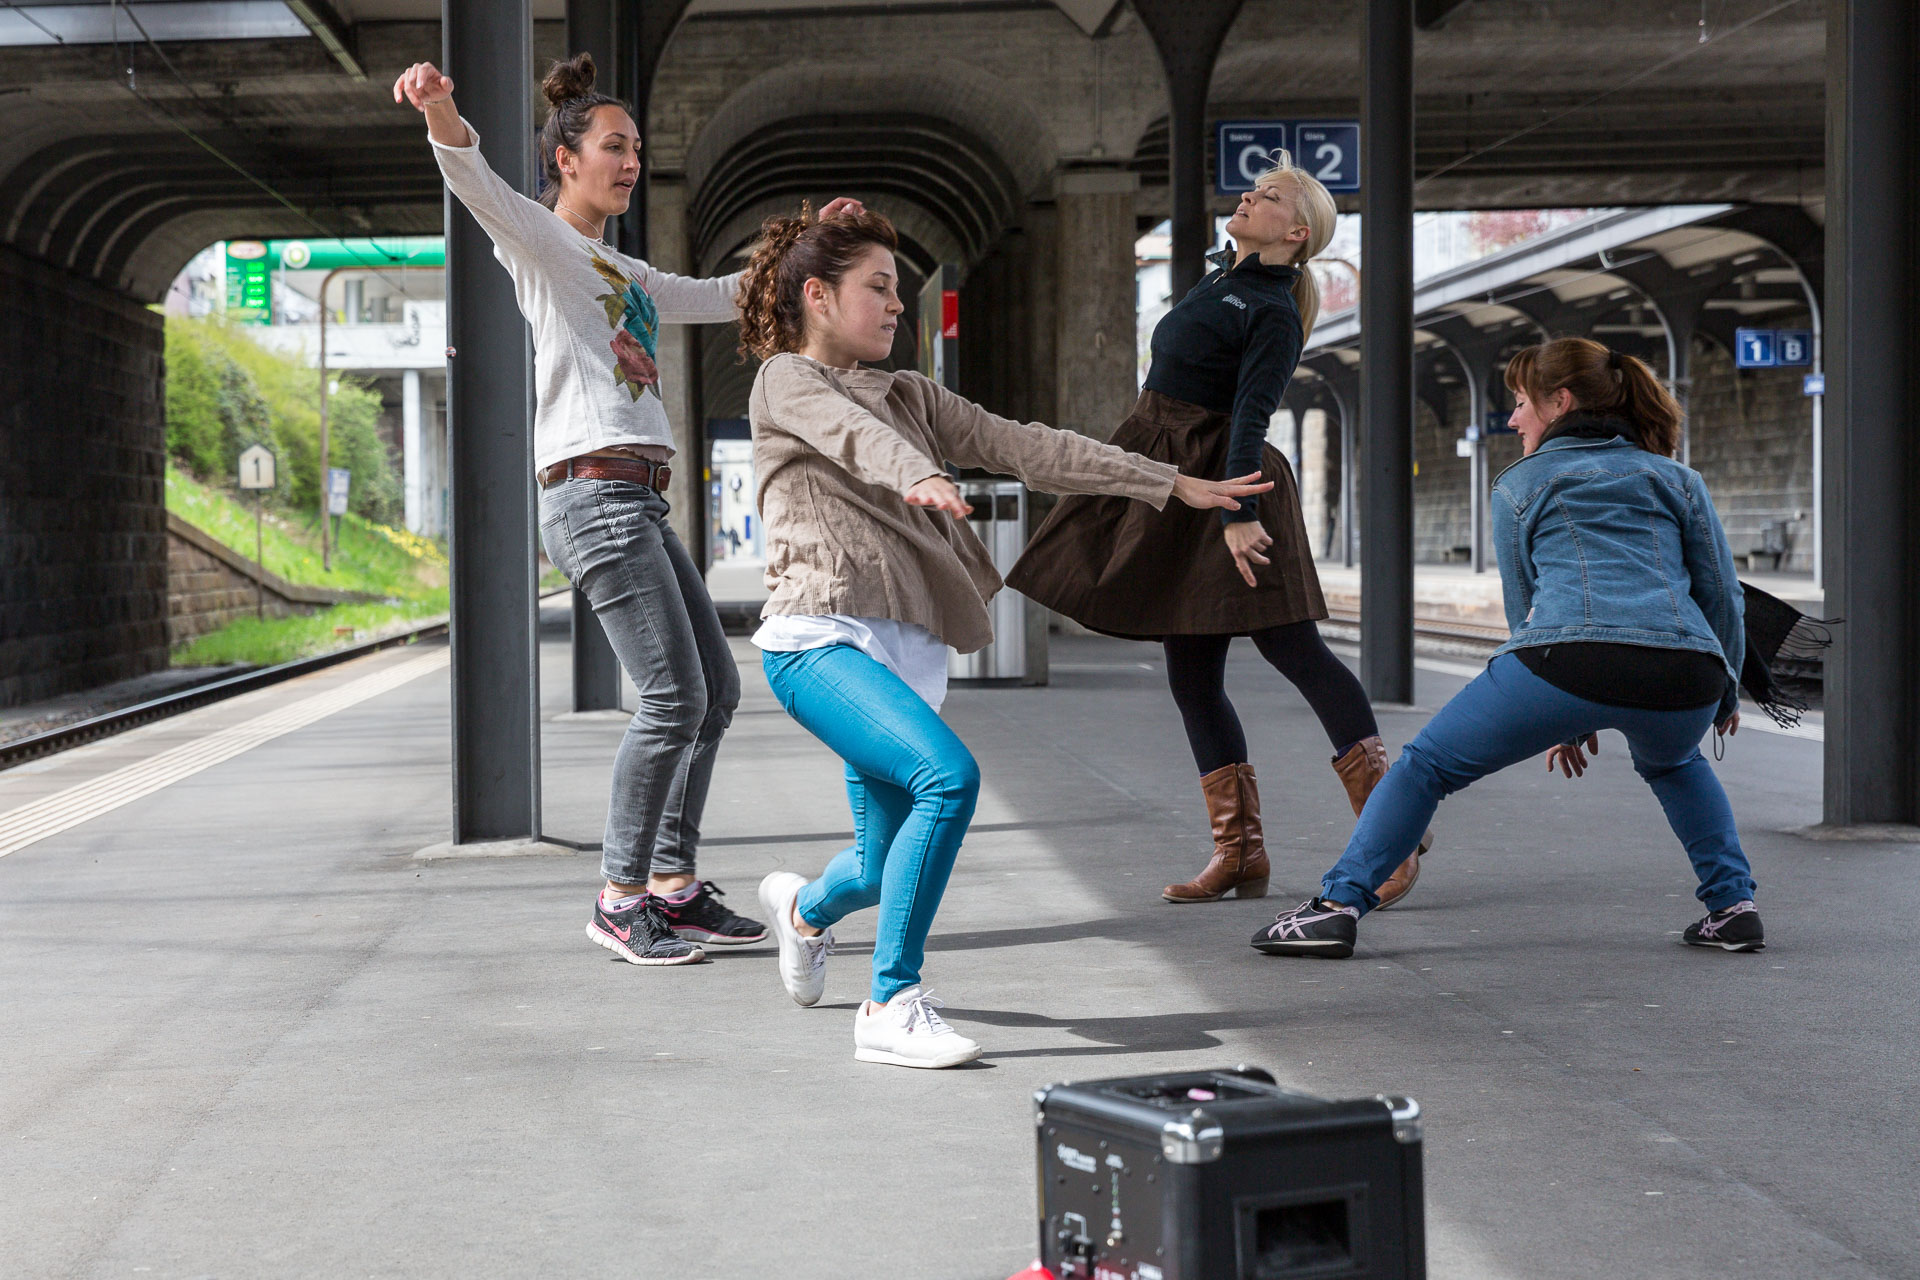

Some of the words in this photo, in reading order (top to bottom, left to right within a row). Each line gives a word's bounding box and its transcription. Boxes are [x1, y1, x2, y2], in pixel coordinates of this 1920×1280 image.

[1238, 144, 1268, 181] C
[1315, 142, 1343, 180] 2
[1750, 340, 1762, 362] 1
[253, 456, 261, 482] 1
